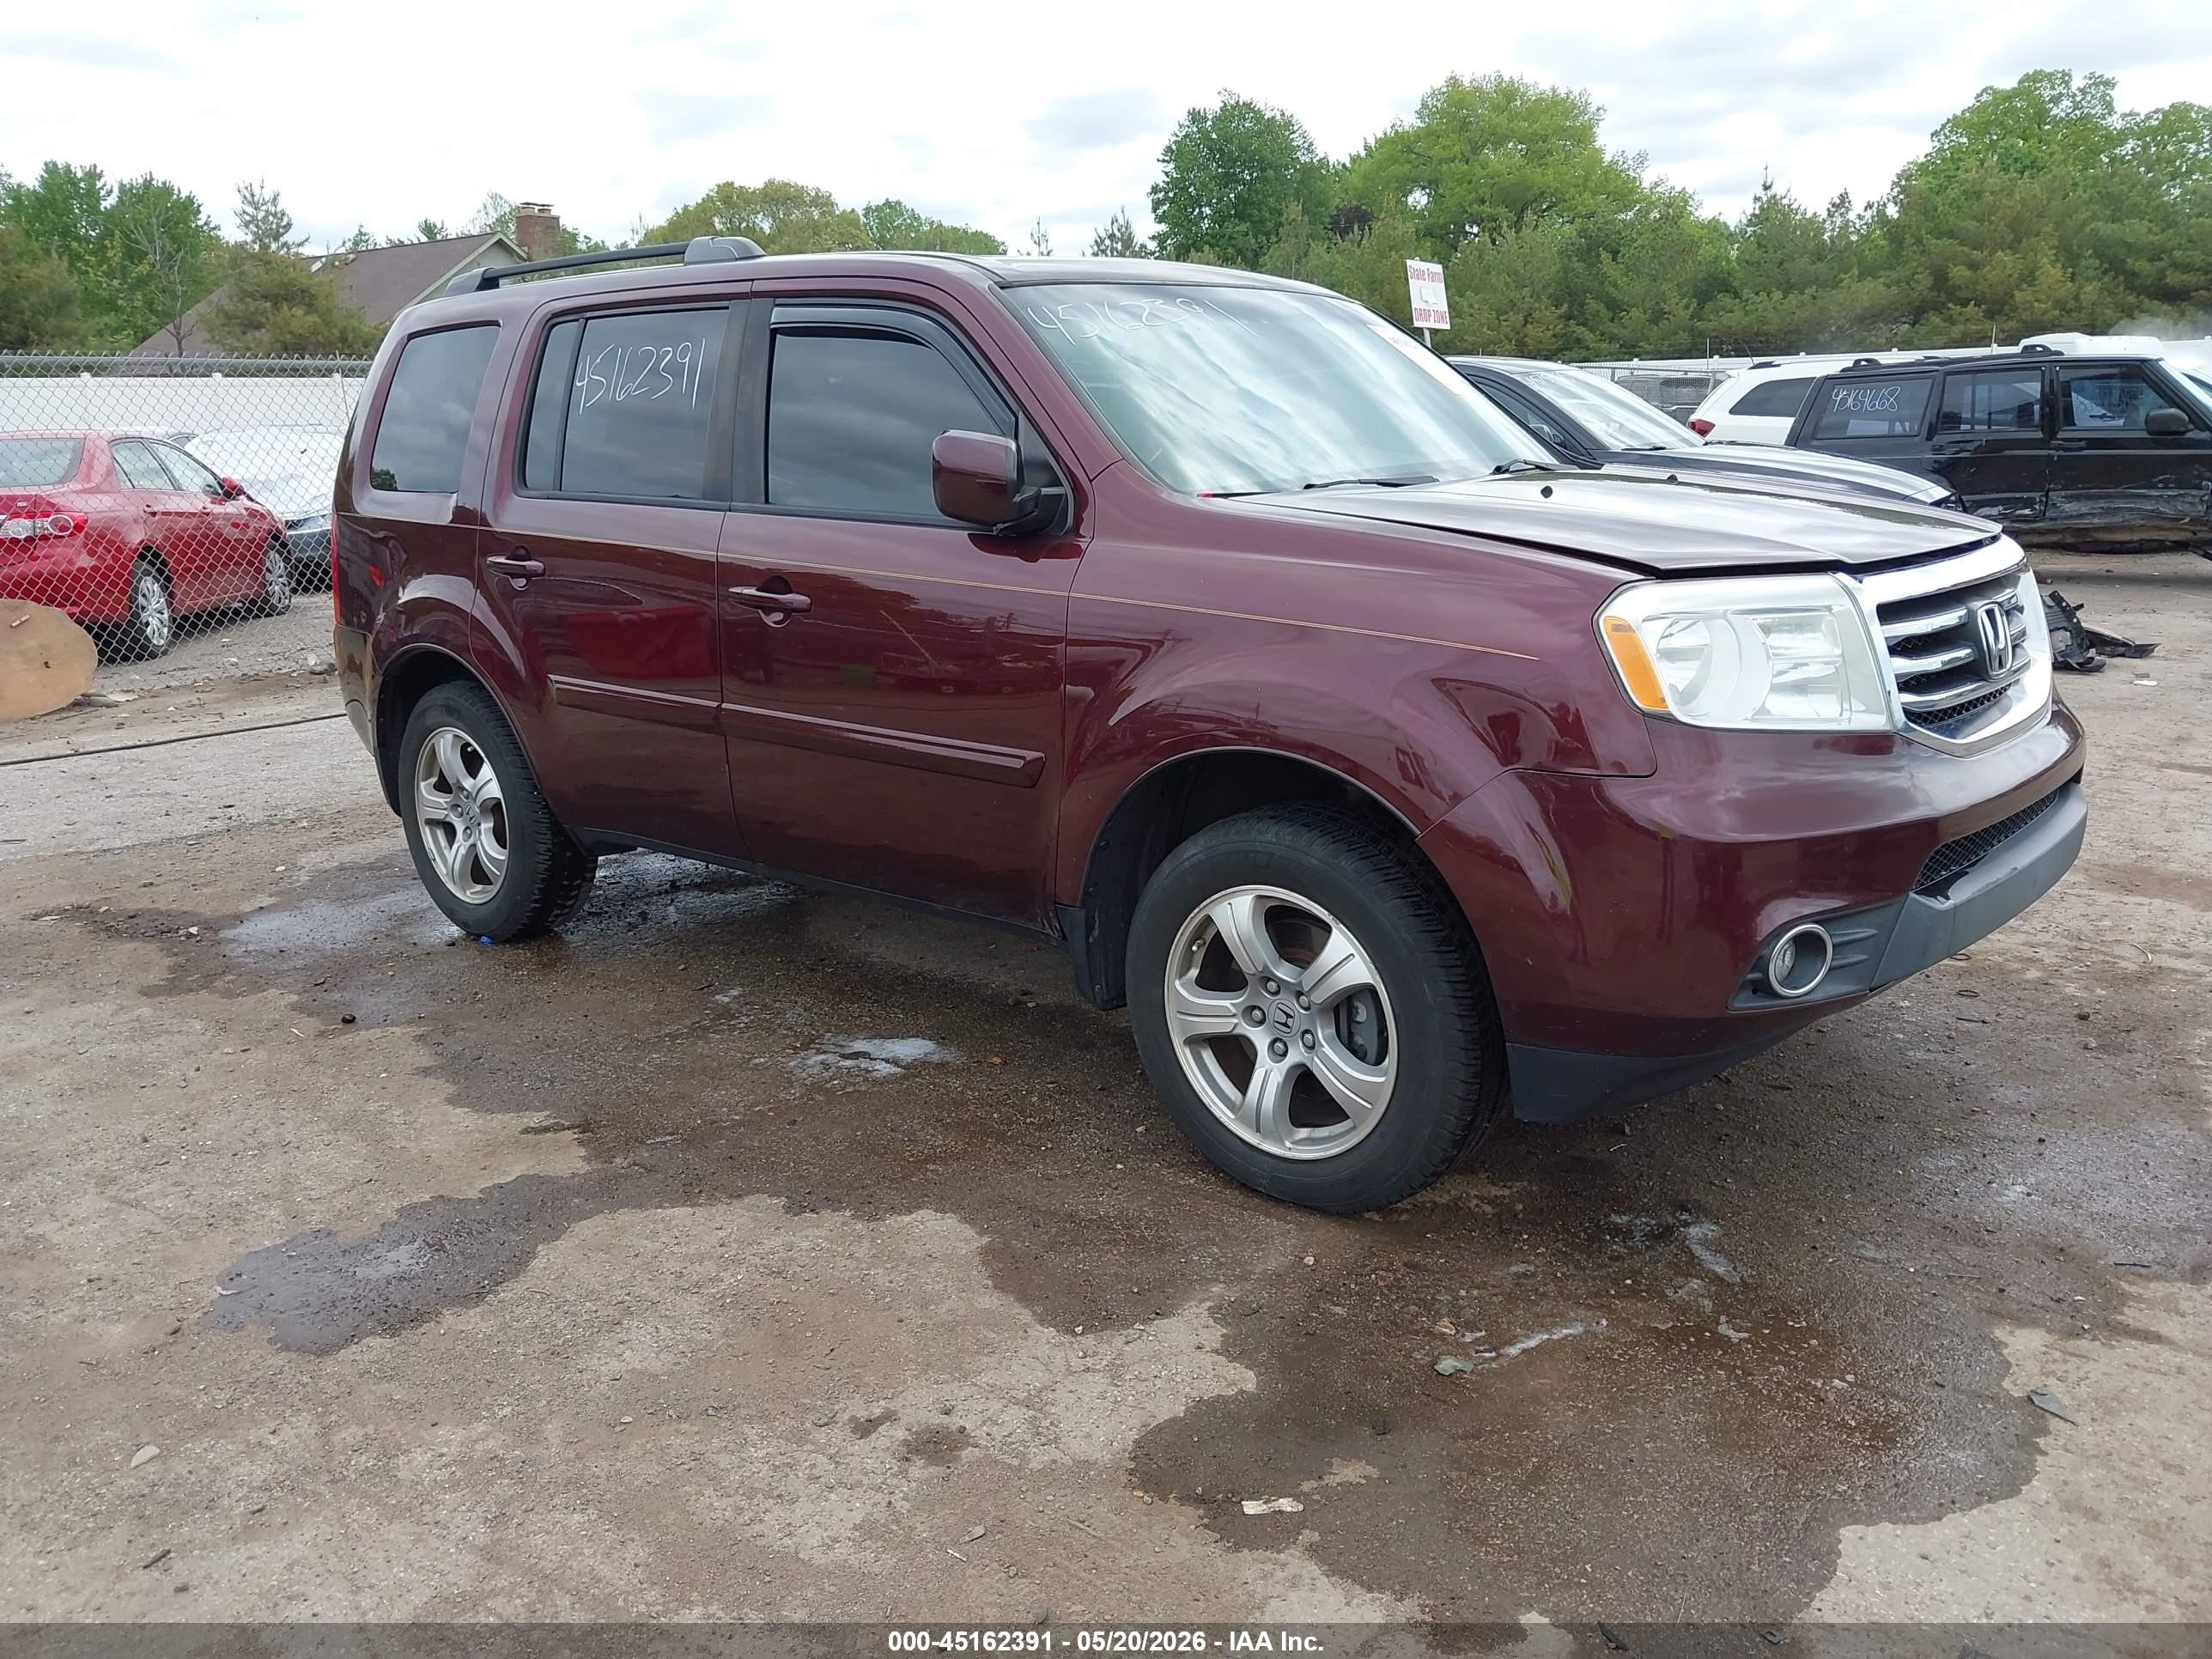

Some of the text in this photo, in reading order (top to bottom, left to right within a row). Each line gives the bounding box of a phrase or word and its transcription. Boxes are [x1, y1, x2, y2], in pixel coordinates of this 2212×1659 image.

[1409, 265, 1443, 283] State Farm
[1027, 298, 1257, 345] 45162391
[1414, 308, 1449, 325] DROP ZONE
[575, 337, 706, 416] 45162391
[1832, 386, 1901, 413] 45164668
